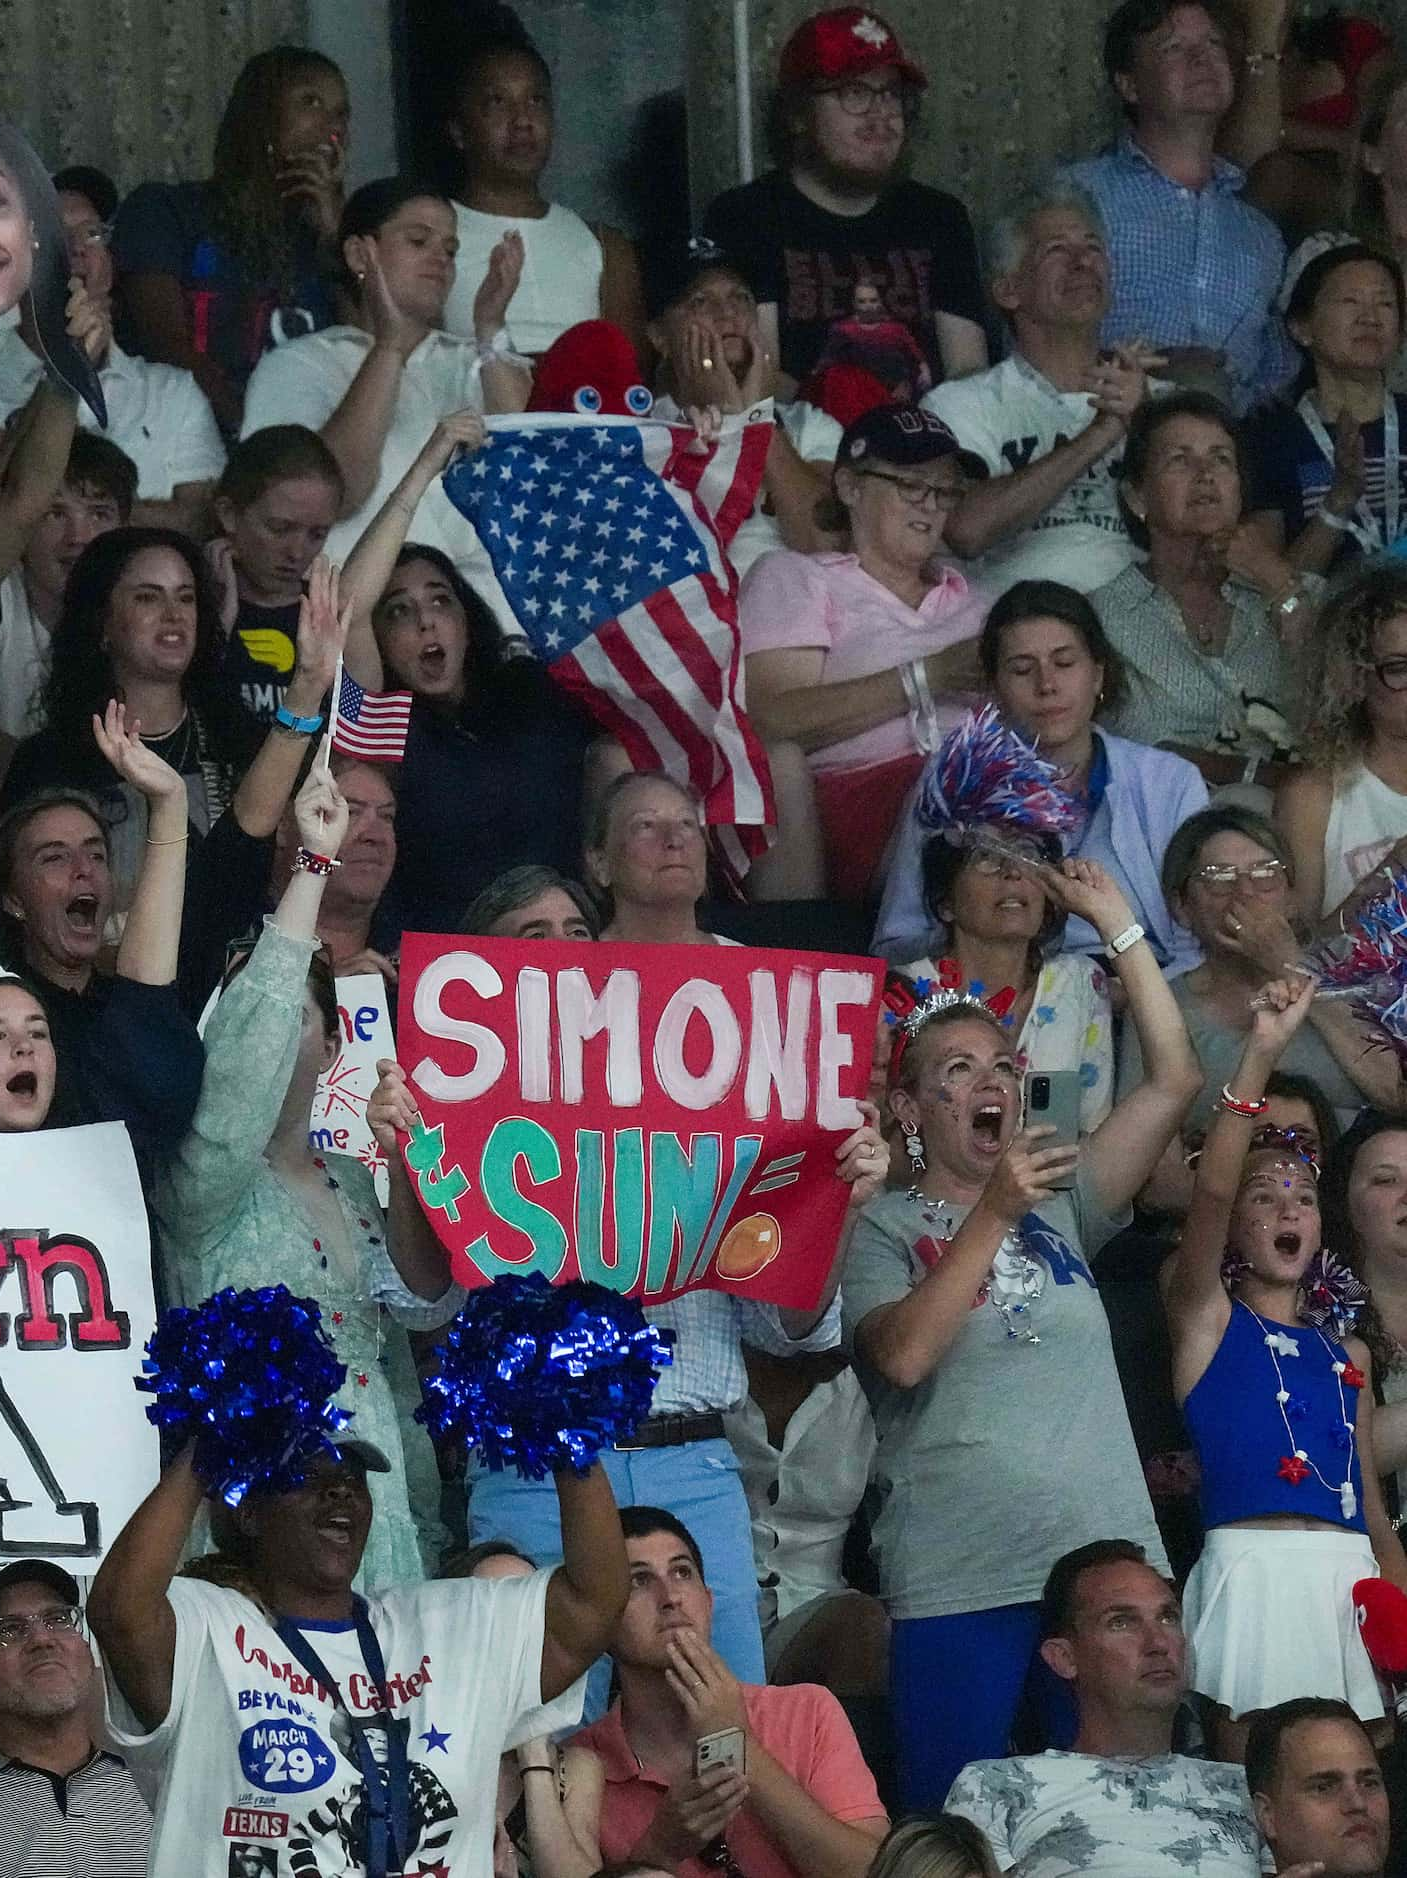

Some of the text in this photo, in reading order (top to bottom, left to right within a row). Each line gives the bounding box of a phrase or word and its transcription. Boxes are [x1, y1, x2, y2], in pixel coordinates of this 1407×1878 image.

[787, 284, 932, 321] BLCK
[893, 408, 954, 435] US
[411, 950, 874, 1131] SIMONE
[901, 1120, 927, 1172] USA
[465, 1115, 764, 1295] SUNI
[349, 1655, 432, 1713] Carter
[238, 1689, 317, 1725] BEYON
[252, 1728, 309, 1750] MARCH
[264, 1747, 315, 1783] 29
[229, 1811, 283, 1838] TEXAS
